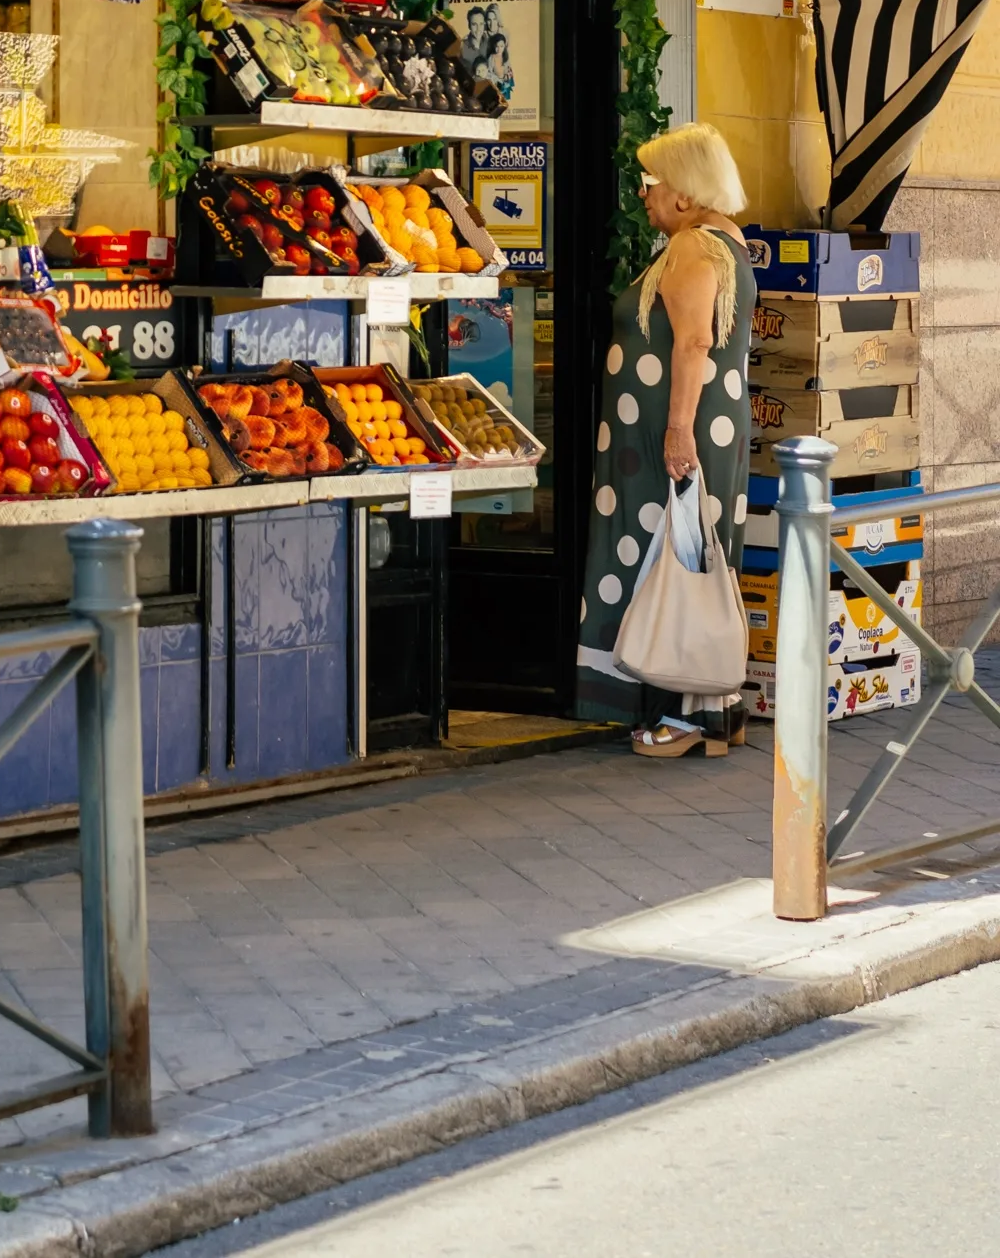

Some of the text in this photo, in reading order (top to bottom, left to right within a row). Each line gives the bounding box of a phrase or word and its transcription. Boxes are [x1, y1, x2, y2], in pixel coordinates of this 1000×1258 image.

[490, 143, 545, 159] CARLÚS
[490, 157, 545, 168] SEGURIDAD
[510, 251, 526, 265] 64
[528, 251, 544, 265] 04
[73, 283, 173, 311] Domicilio
[132, 320, 175, 360] 88
[858, 627, 884, 642] Coplaca
